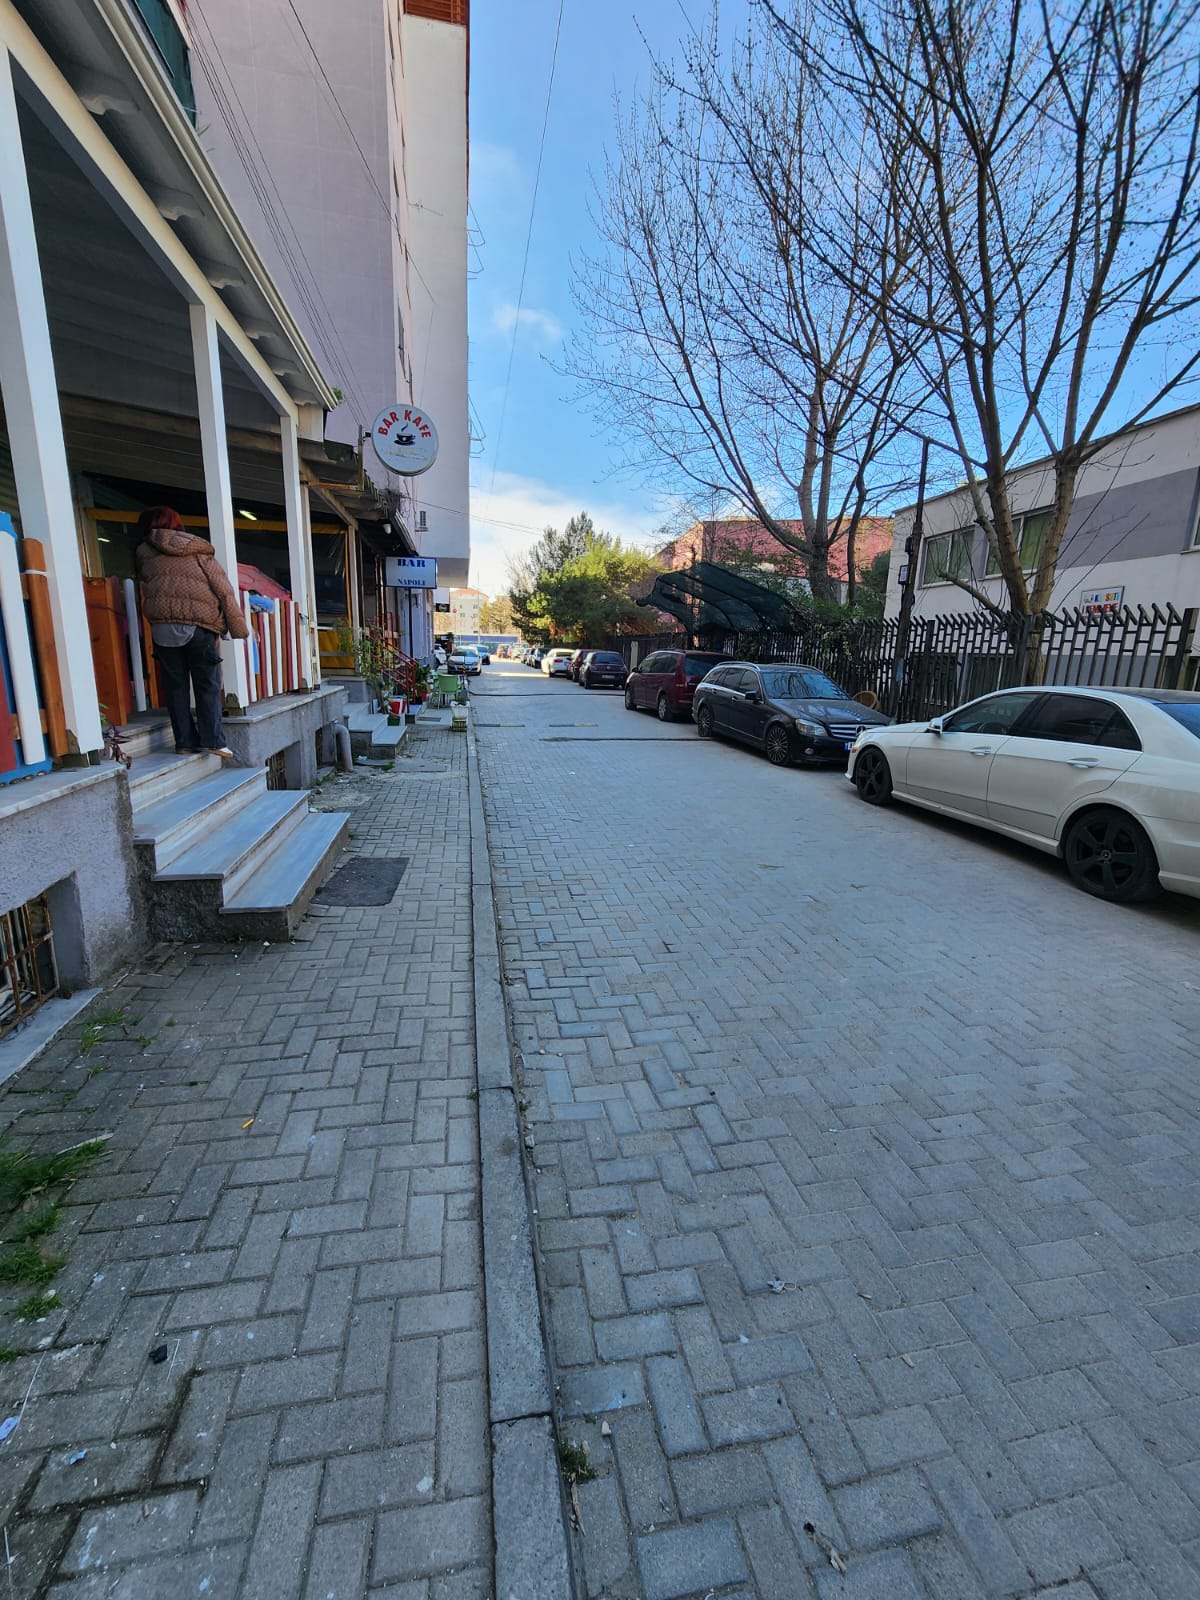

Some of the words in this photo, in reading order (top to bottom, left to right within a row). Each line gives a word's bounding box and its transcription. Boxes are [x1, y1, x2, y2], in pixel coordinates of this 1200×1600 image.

[377, 411, 400, 436] BAR
[404, 409, 432, 438] KAFE
[397, 559, 426, 568] BAR
[397, 579, 426, 587] NAPOLI
